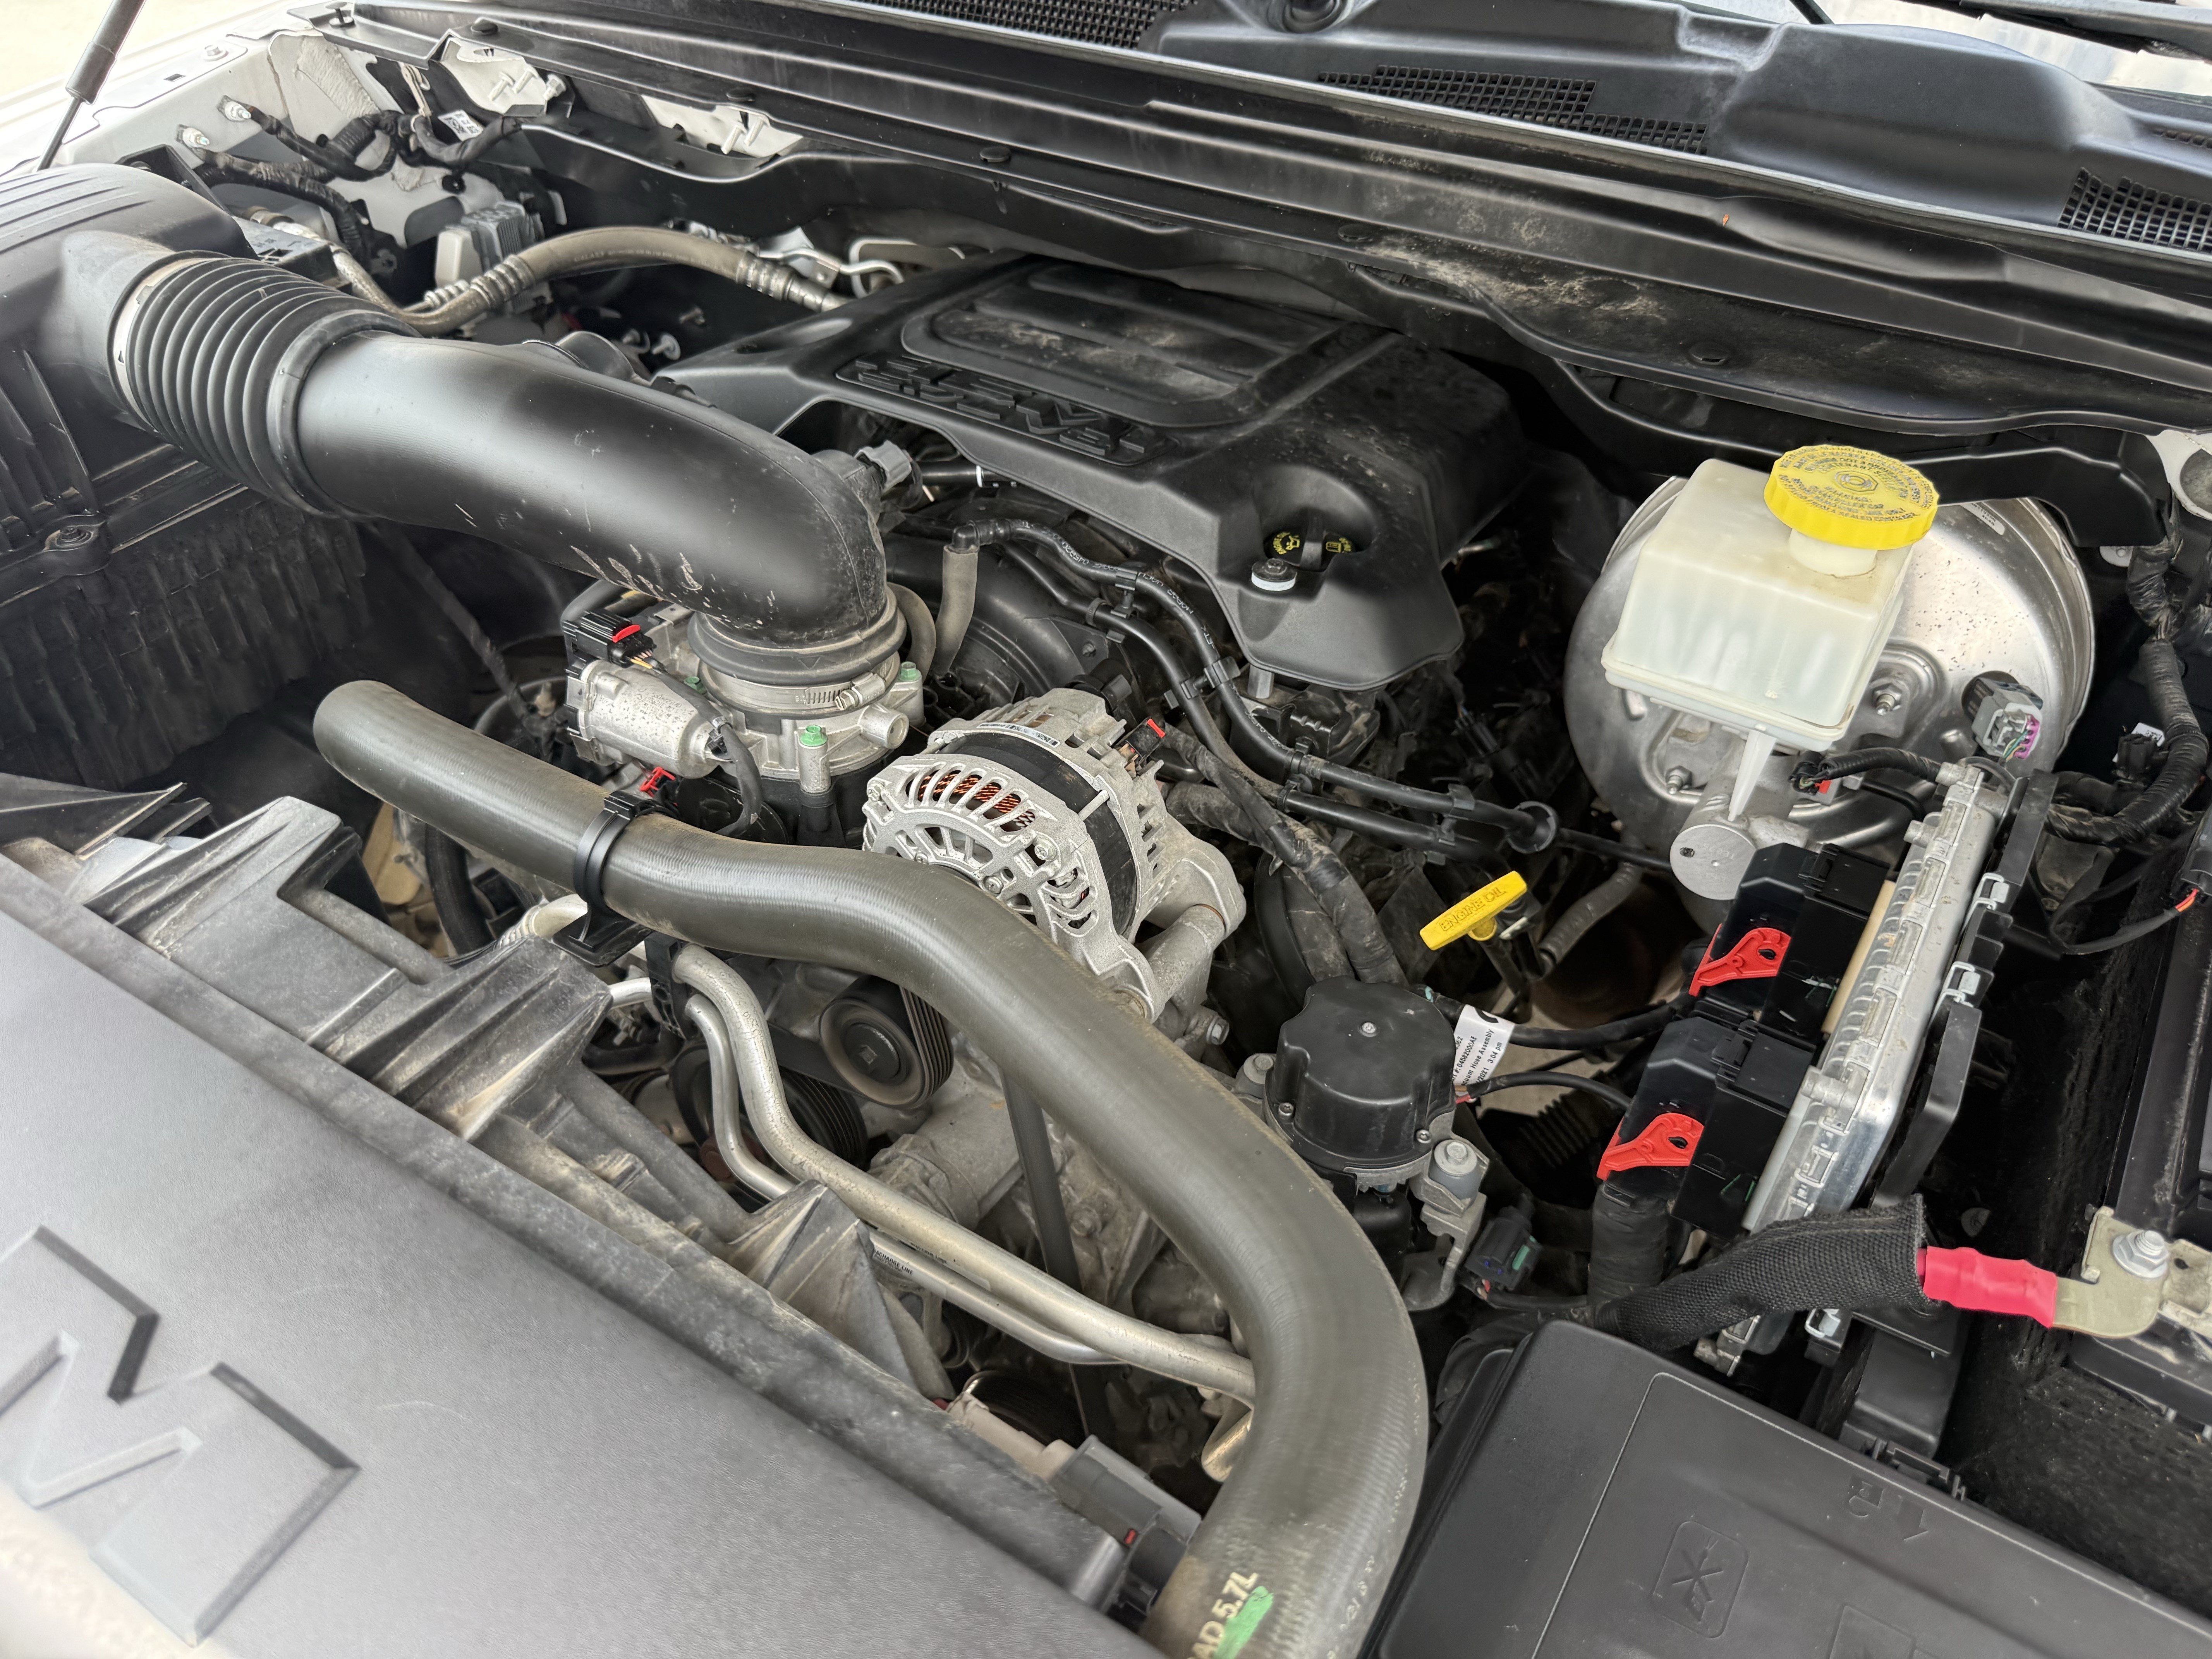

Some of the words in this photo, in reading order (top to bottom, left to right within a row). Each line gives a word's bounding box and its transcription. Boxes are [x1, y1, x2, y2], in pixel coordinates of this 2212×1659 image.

[1273, 538, 1287, 555] ENGINE
[1439, 897, 1486, 932] ENGINE
[1484, 886, 1506, 903] OIL
[1470, 1056, 1482, 1069] Hose
[1481, 1029, 1494, 1055] Assembly
[1487, 1051, 1498, 1063] 3:04
[1496, 1042, 1502, 1051] pm
[901, 1264, 914, 1275] LINE
[1187, 1621, 1225, 1659] AD
[1211, 1571, 1259, 1618] 5.7L
